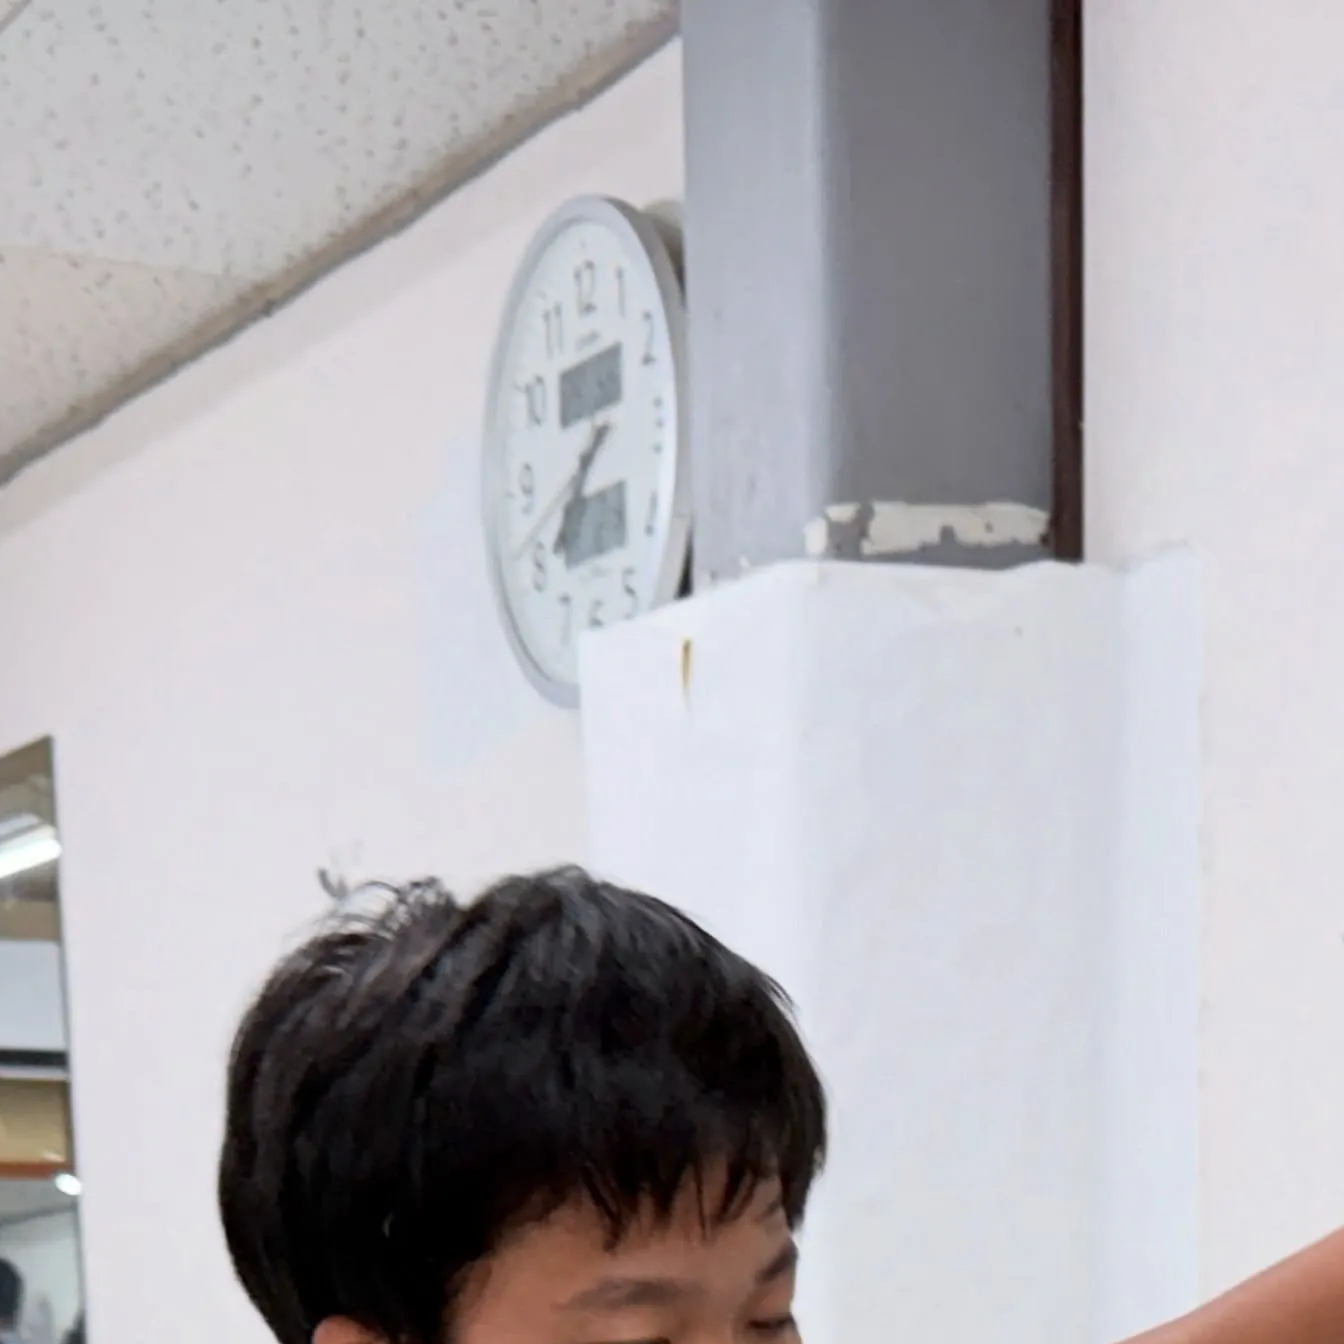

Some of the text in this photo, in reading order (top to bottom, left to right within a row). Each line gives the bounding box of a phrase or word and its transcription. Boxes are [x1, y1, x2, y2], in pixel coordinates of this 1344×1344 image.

[573, 258, 598, 318] 12
[541, 301, 565, 360] 11
[523, 373, 547, 430] 10
[518, 461, 536, 518] 9
[531, 539, 547, 594] 8
[621, 564, 641, 620] 5
